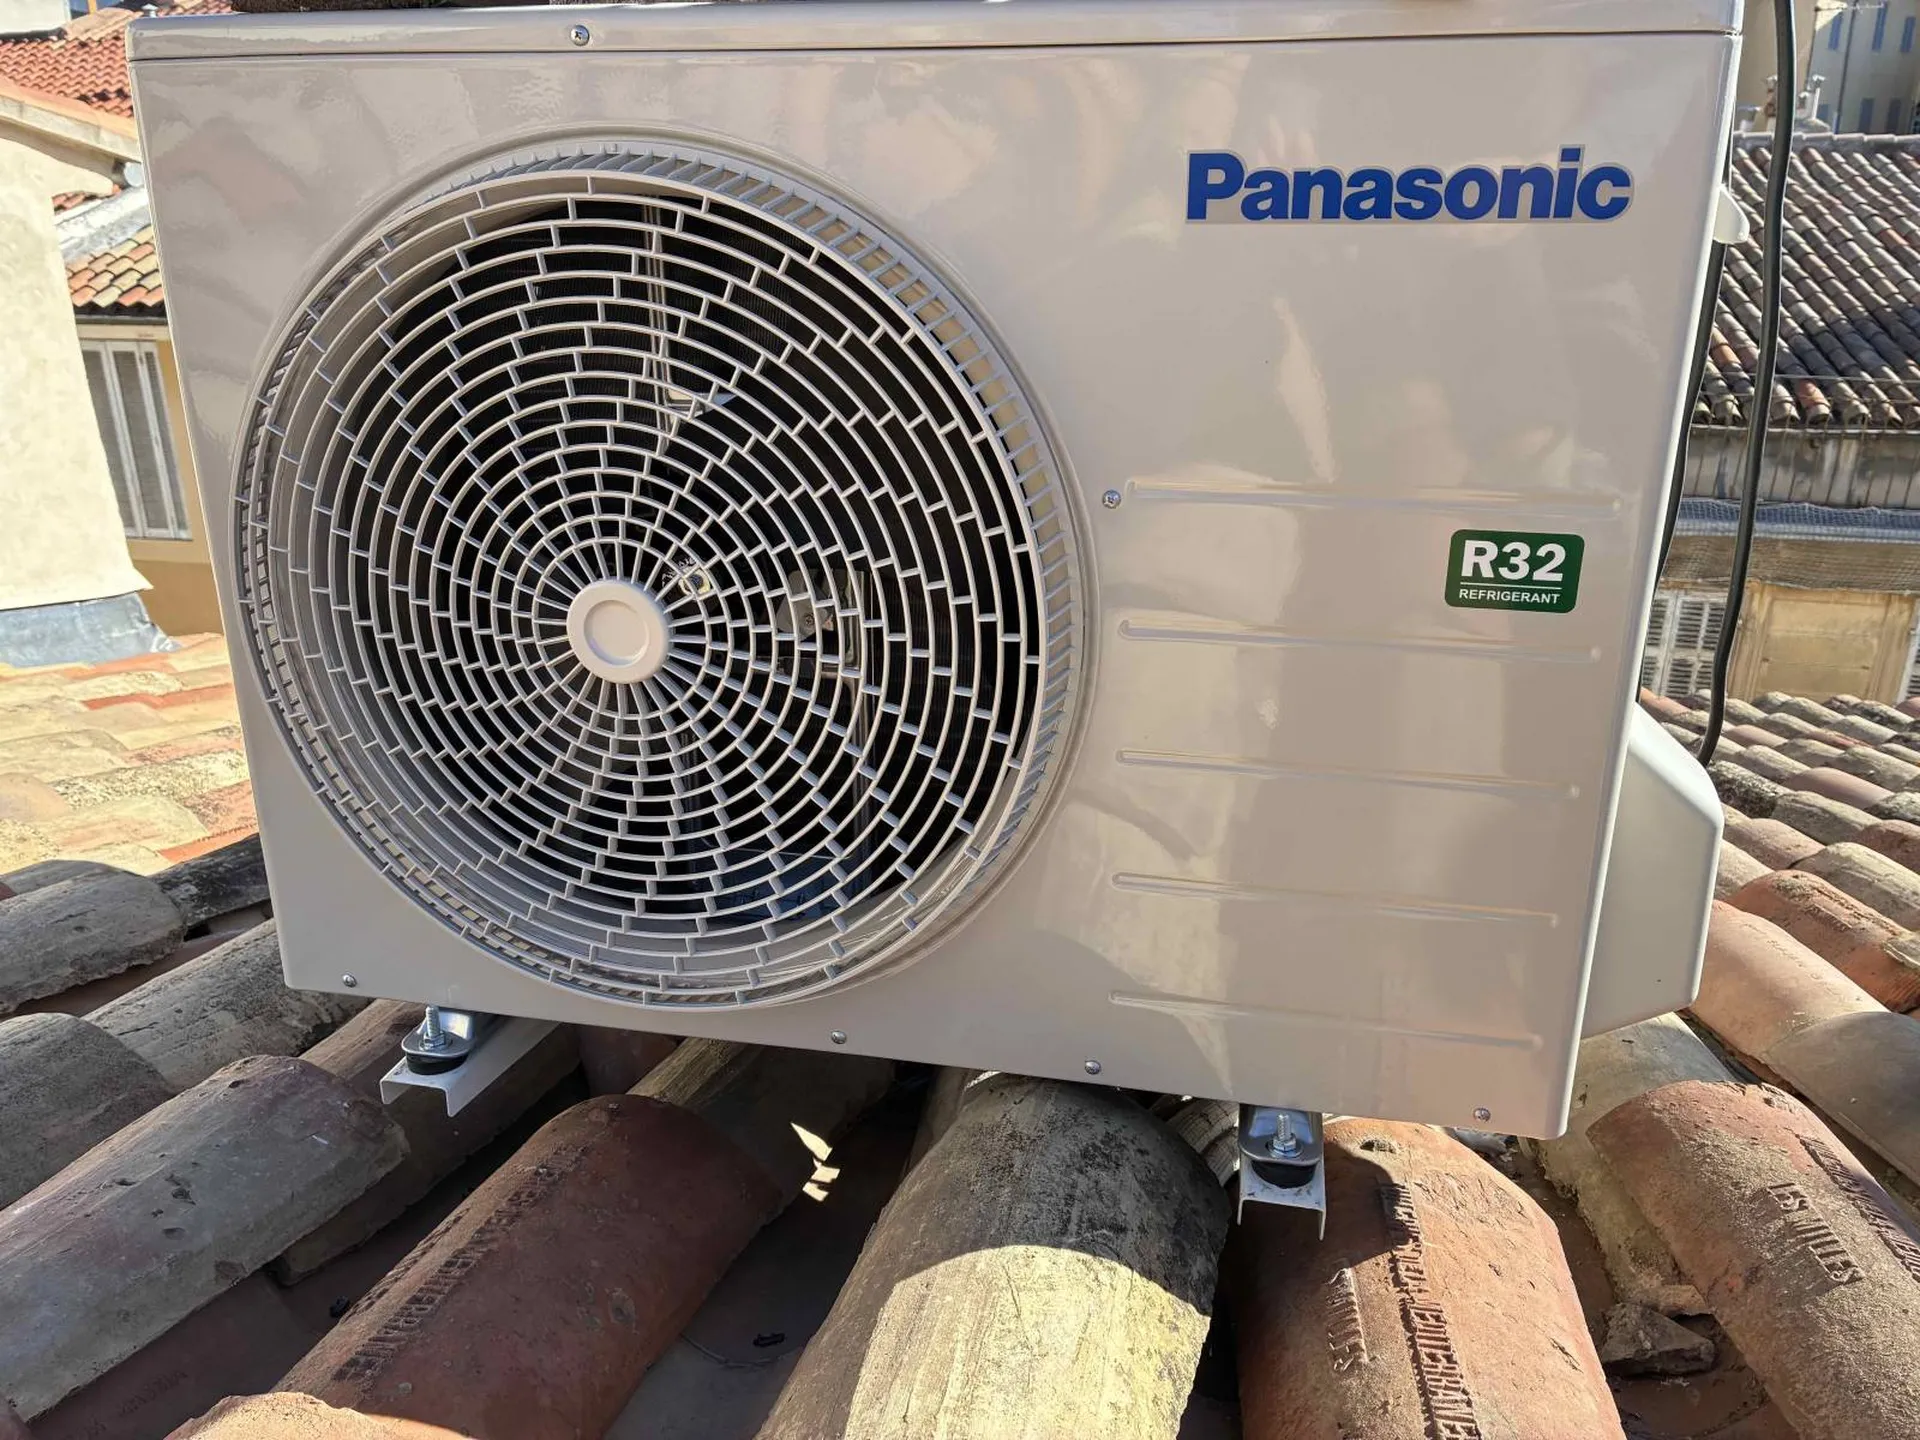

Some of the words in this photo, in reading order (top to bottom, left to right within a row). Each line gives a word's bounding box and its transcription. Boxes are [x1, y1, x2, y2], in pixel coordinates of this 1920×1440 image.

[1187, 146, 1631, 221] Panasonic
[1461, 539, 1566, 582] R32
[1459, 588, 1561, 604] REFRIGERANT
